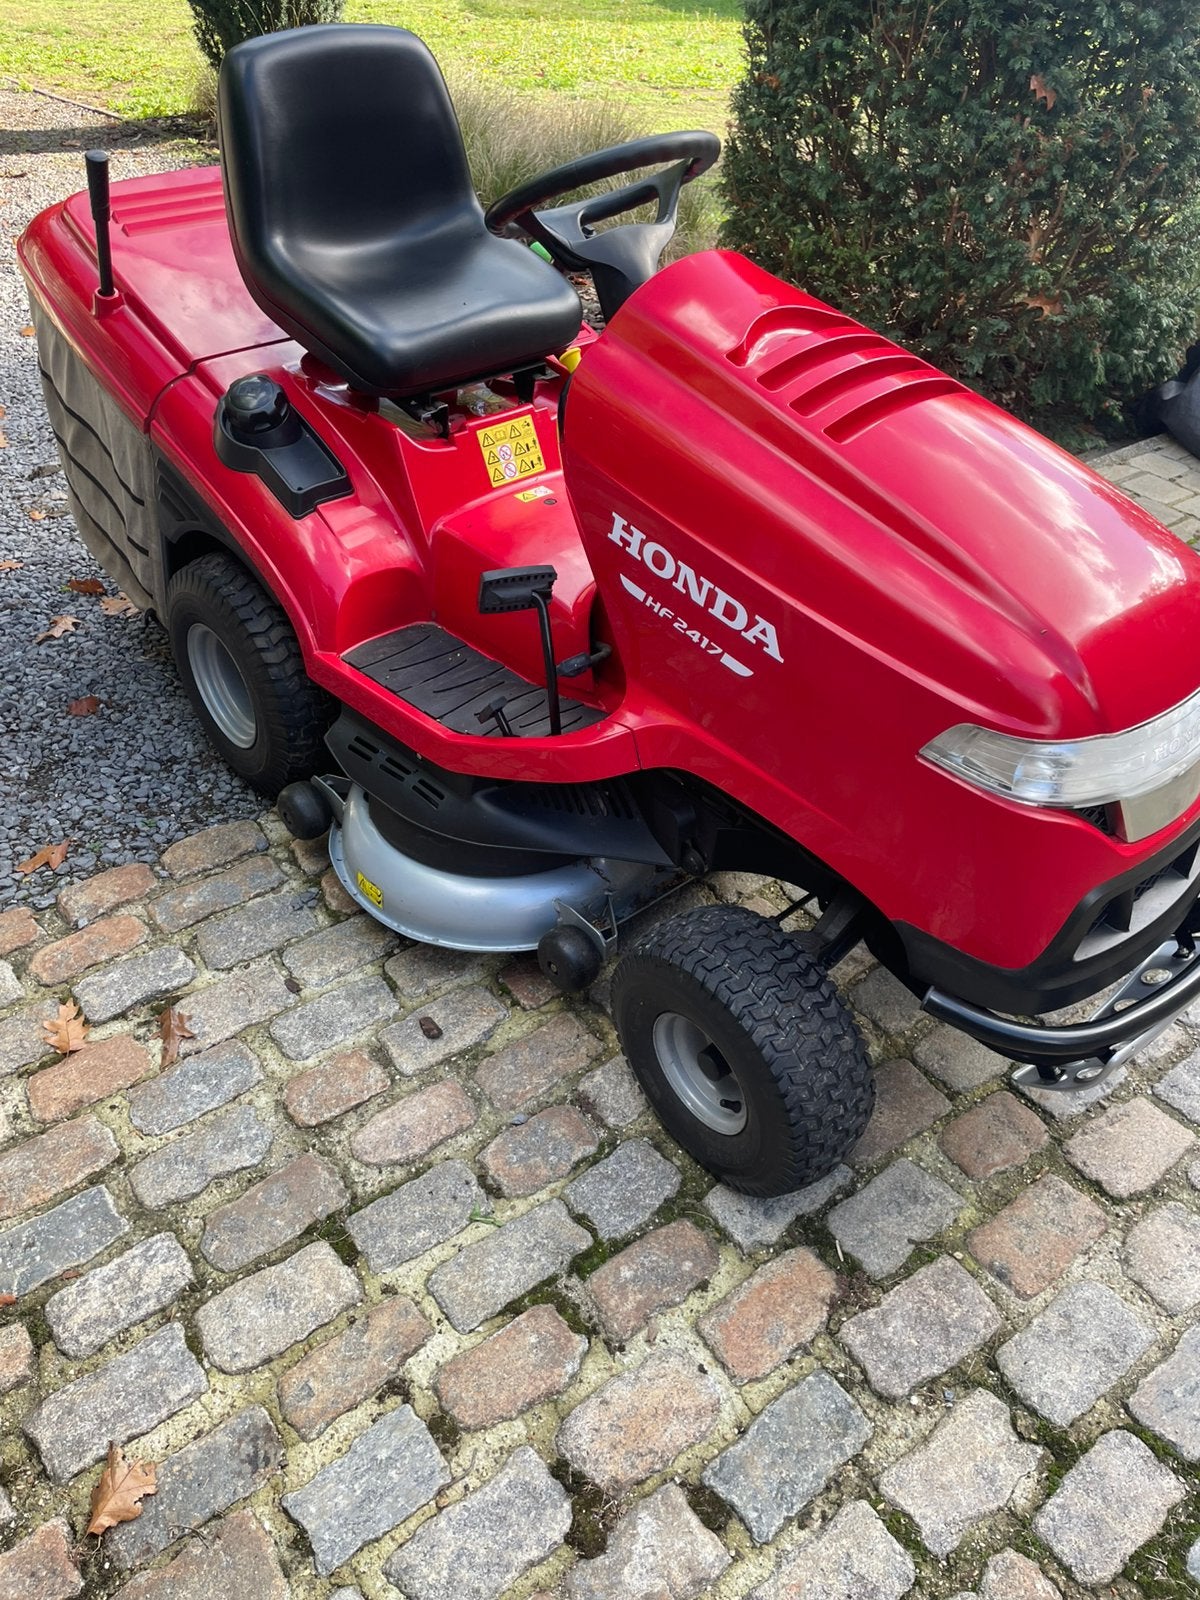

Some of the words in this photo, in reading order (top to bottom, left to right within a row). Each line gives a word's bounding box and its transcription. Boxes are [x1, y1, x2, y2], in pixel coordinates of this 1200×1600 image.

[607, 511, 785, 664] HONDA
[645, 595, 675, 619] HF
[673, 617, 723, 655] 2417
